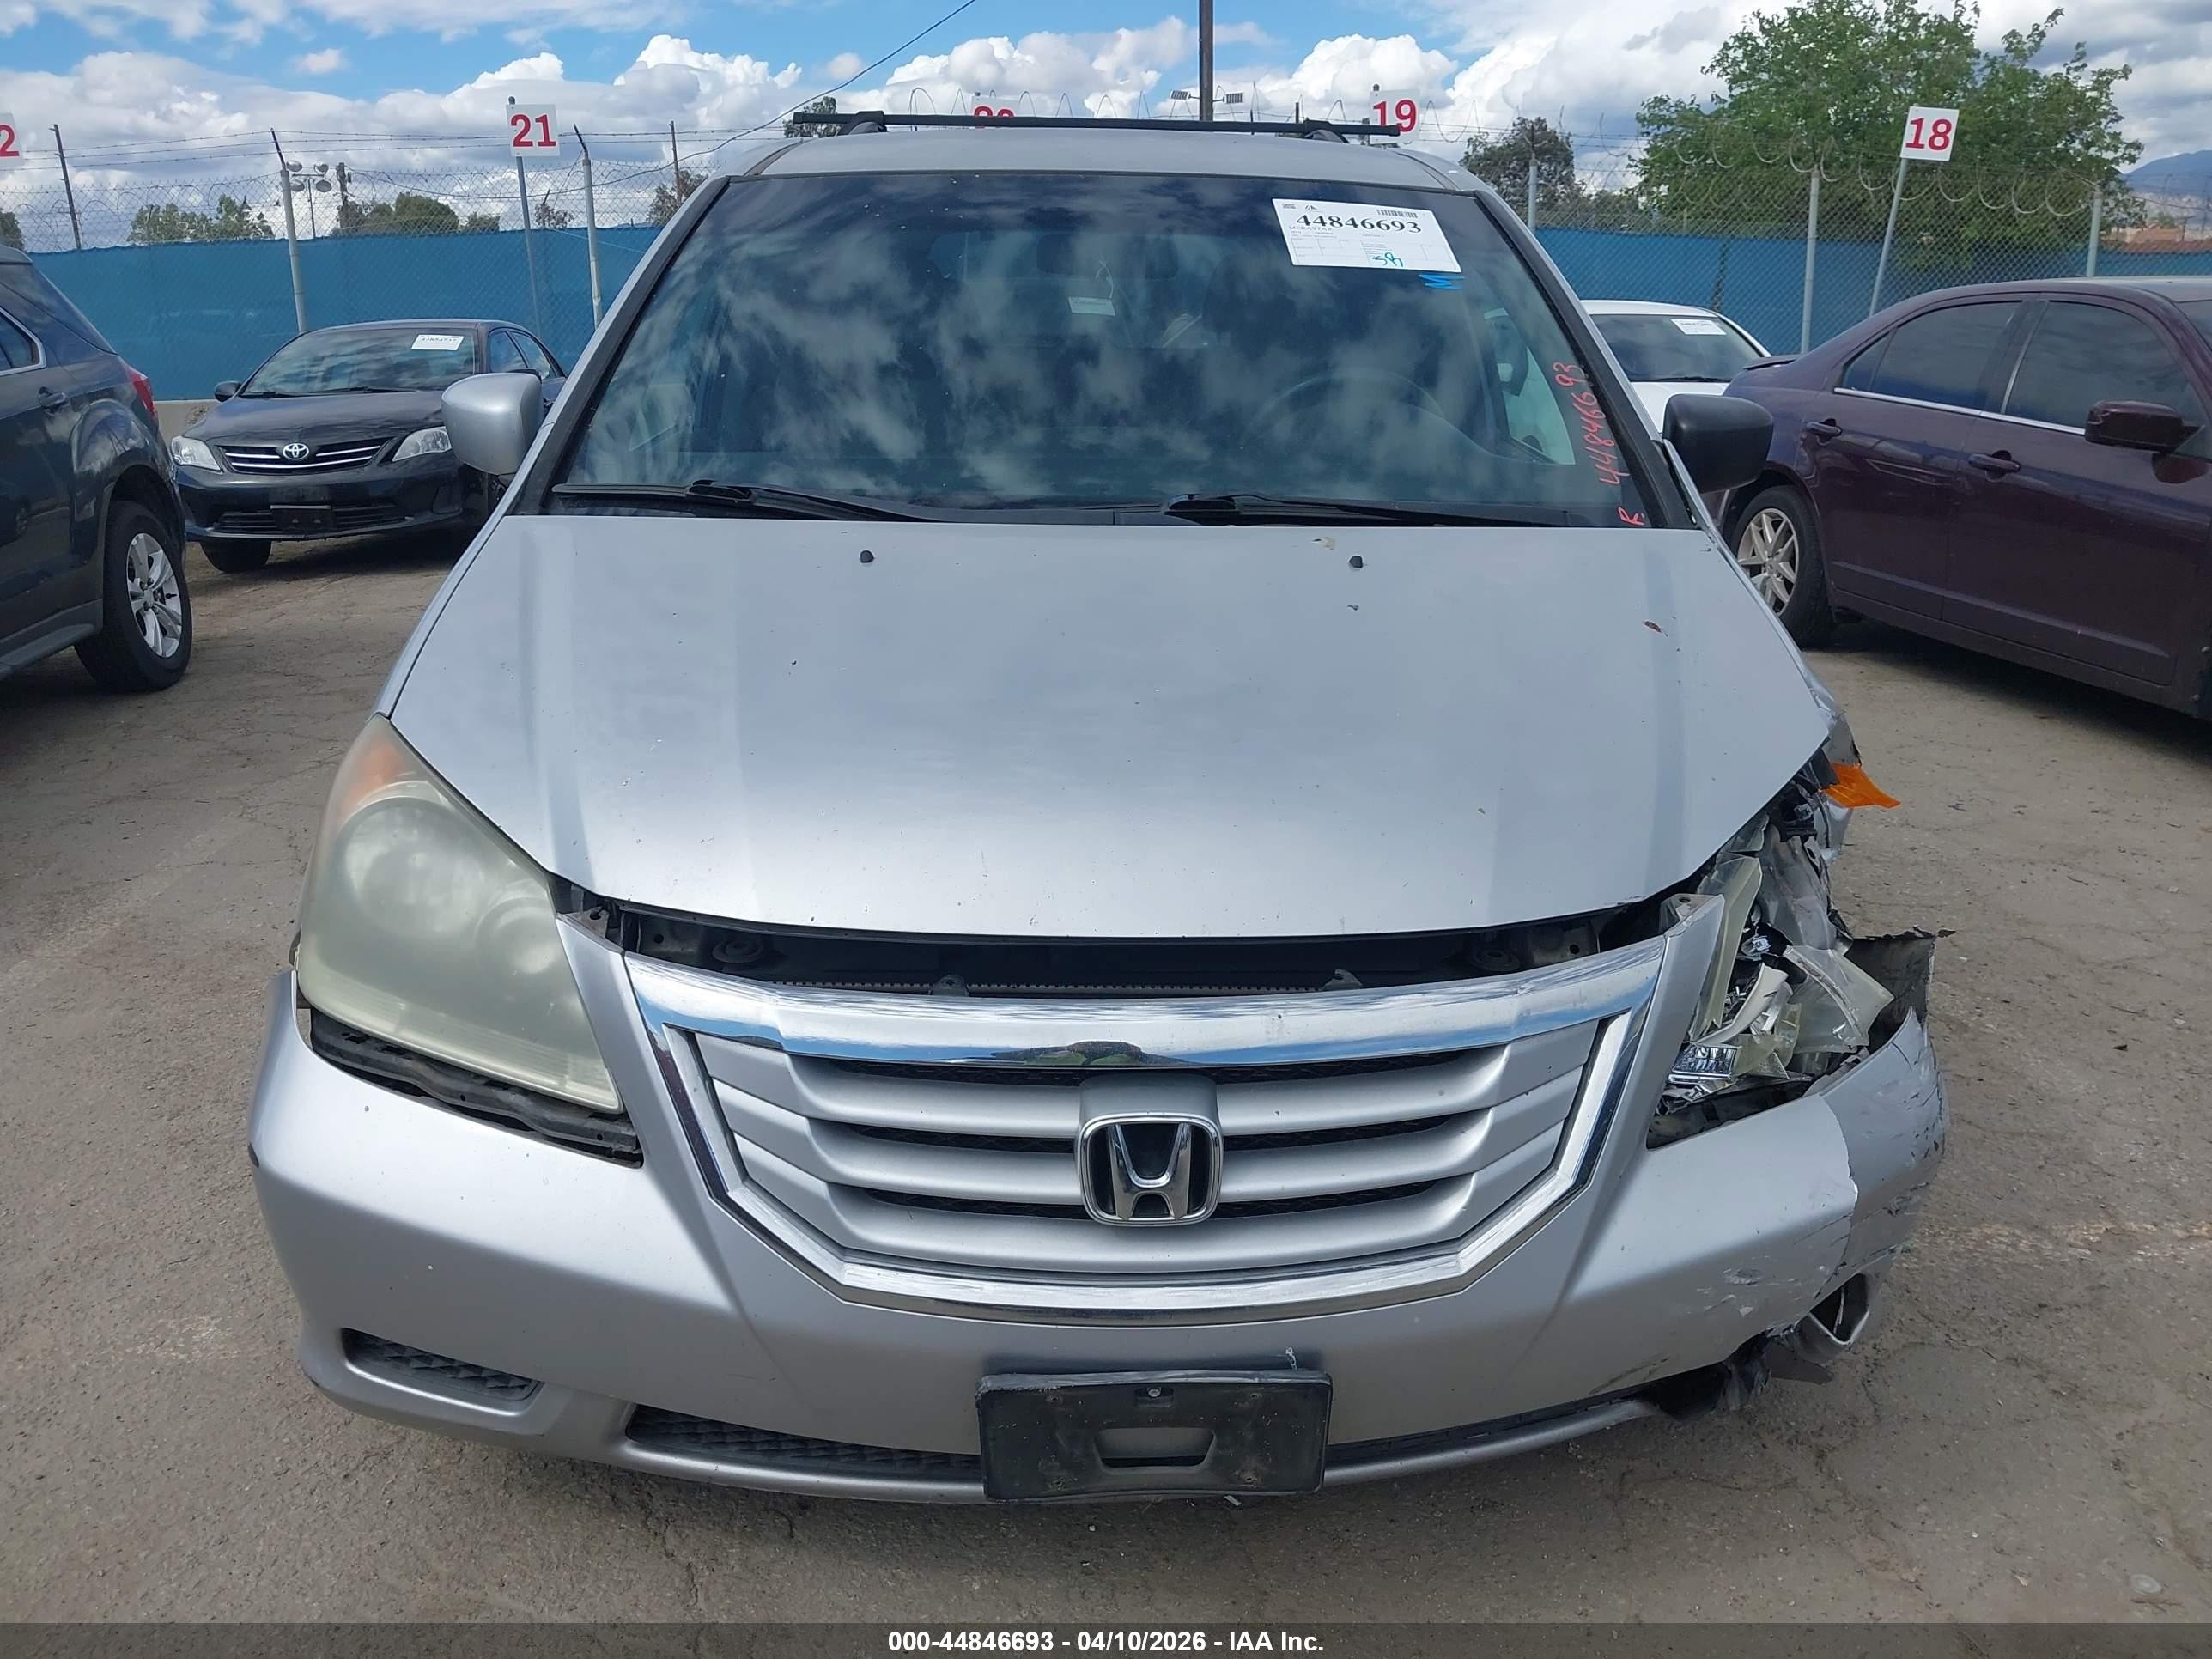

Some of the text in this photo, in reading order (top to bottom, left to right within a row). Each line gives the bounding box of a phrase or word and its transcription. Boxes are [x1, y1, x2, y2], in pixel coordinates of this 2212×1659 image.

[510, 113, 557, 147] 21
[1373, 99, 1417, 132] 19
[1905, 117, 1952, 150] 18
[1296, 214, 1422, 234] 44846693
